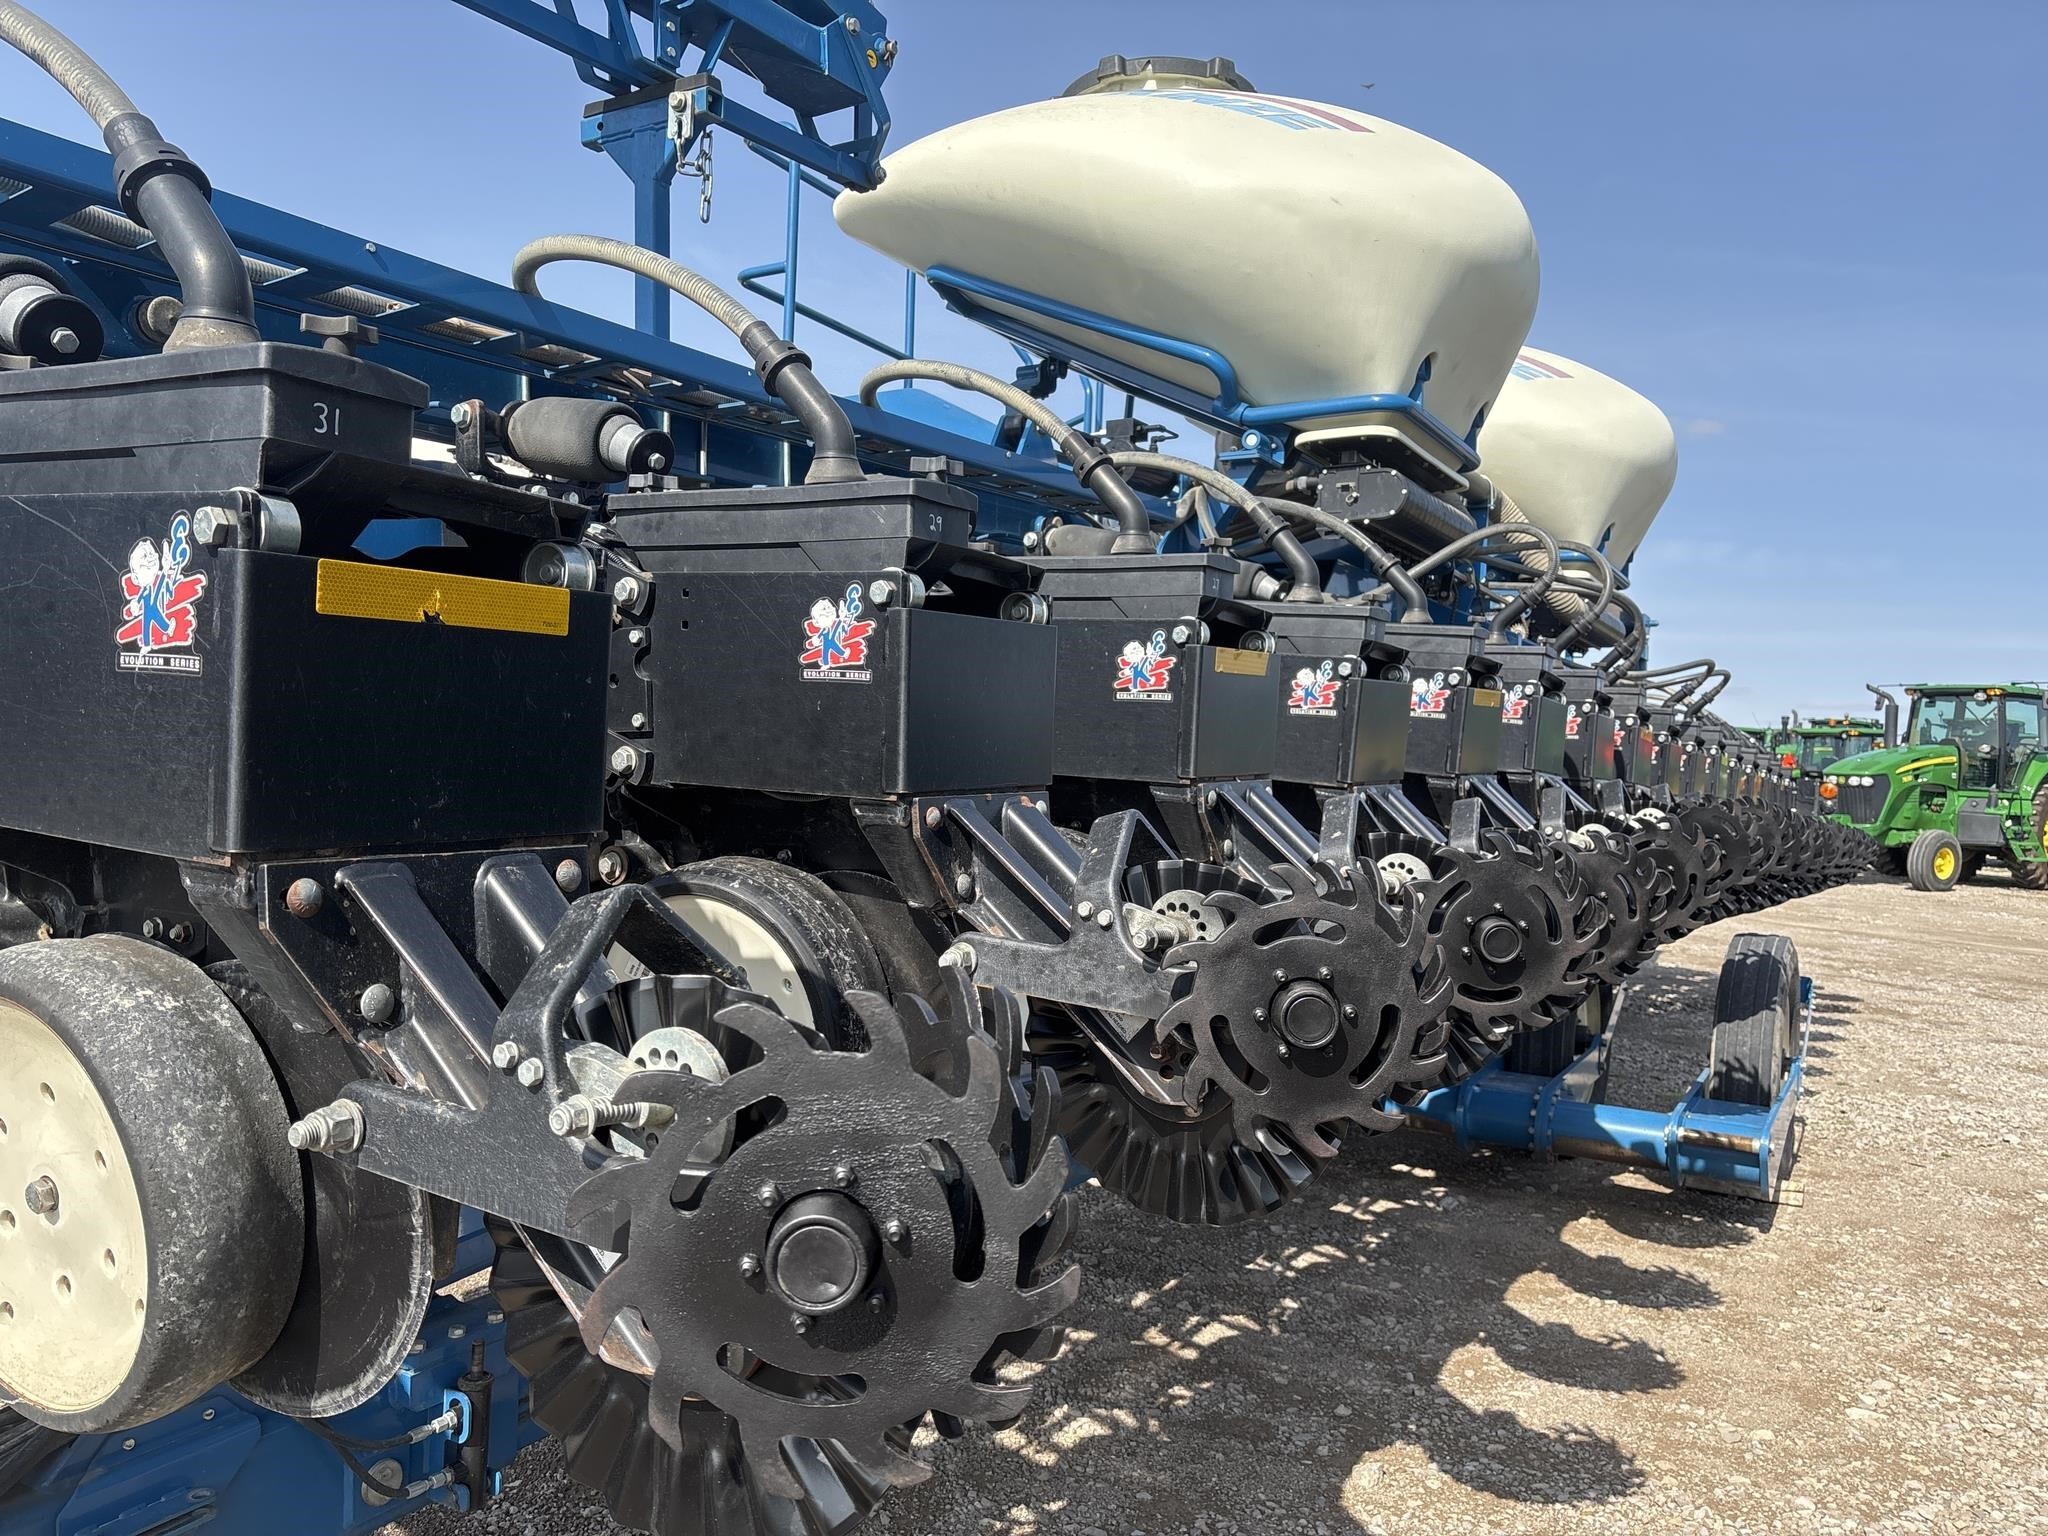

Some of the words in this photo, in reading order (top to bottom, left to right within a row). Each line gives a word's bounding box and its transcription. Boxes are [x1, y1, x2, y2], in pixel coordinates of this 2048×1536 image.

[313, 402, 340, 436] 31
[929, 513, 943, 532] 29
[120, 655, 164, 666] EVOLUTION
[170, 657, 200, 669] SERIES
